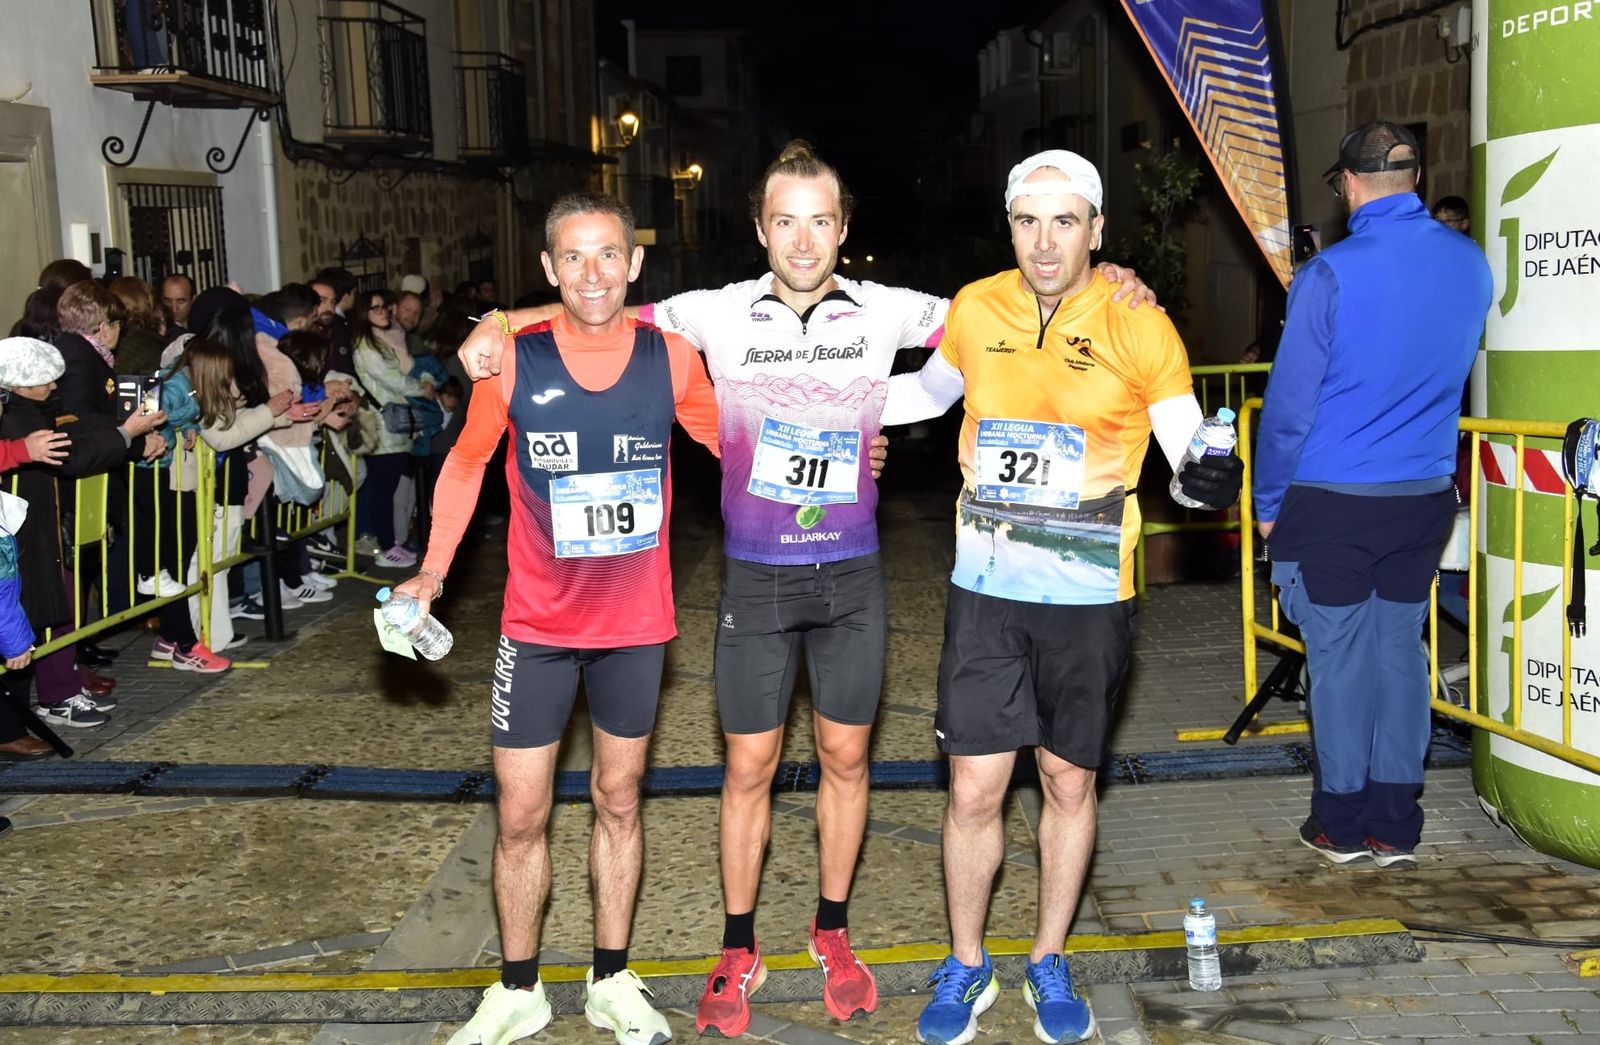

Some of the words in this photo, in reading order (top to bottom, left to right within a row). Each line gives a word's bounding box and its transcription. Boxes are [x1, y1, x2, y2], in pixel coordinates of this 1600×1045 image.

[1502, 0, 1600, 38] DEPOR
[1525, 229, 1600, 251] DIPUTA
[1525, 260, 1548, 278] DE
[740, 347, 792, 366] SIERRA
[795, 350, 809, 359] DE
[807, 344, 863, 363] SEGURA
[1003, 423, 1034, 433] LEGUA
[785, 455, 829, 488] 311
[998, 450, 1051, 486] 321
[584, 502, 635, 536] 109
[780, 532, 842, 544] BUJARKAY
[1528, 659, 1600, 687] DIPUTA
[1528, 685, 1551, 704] DE
